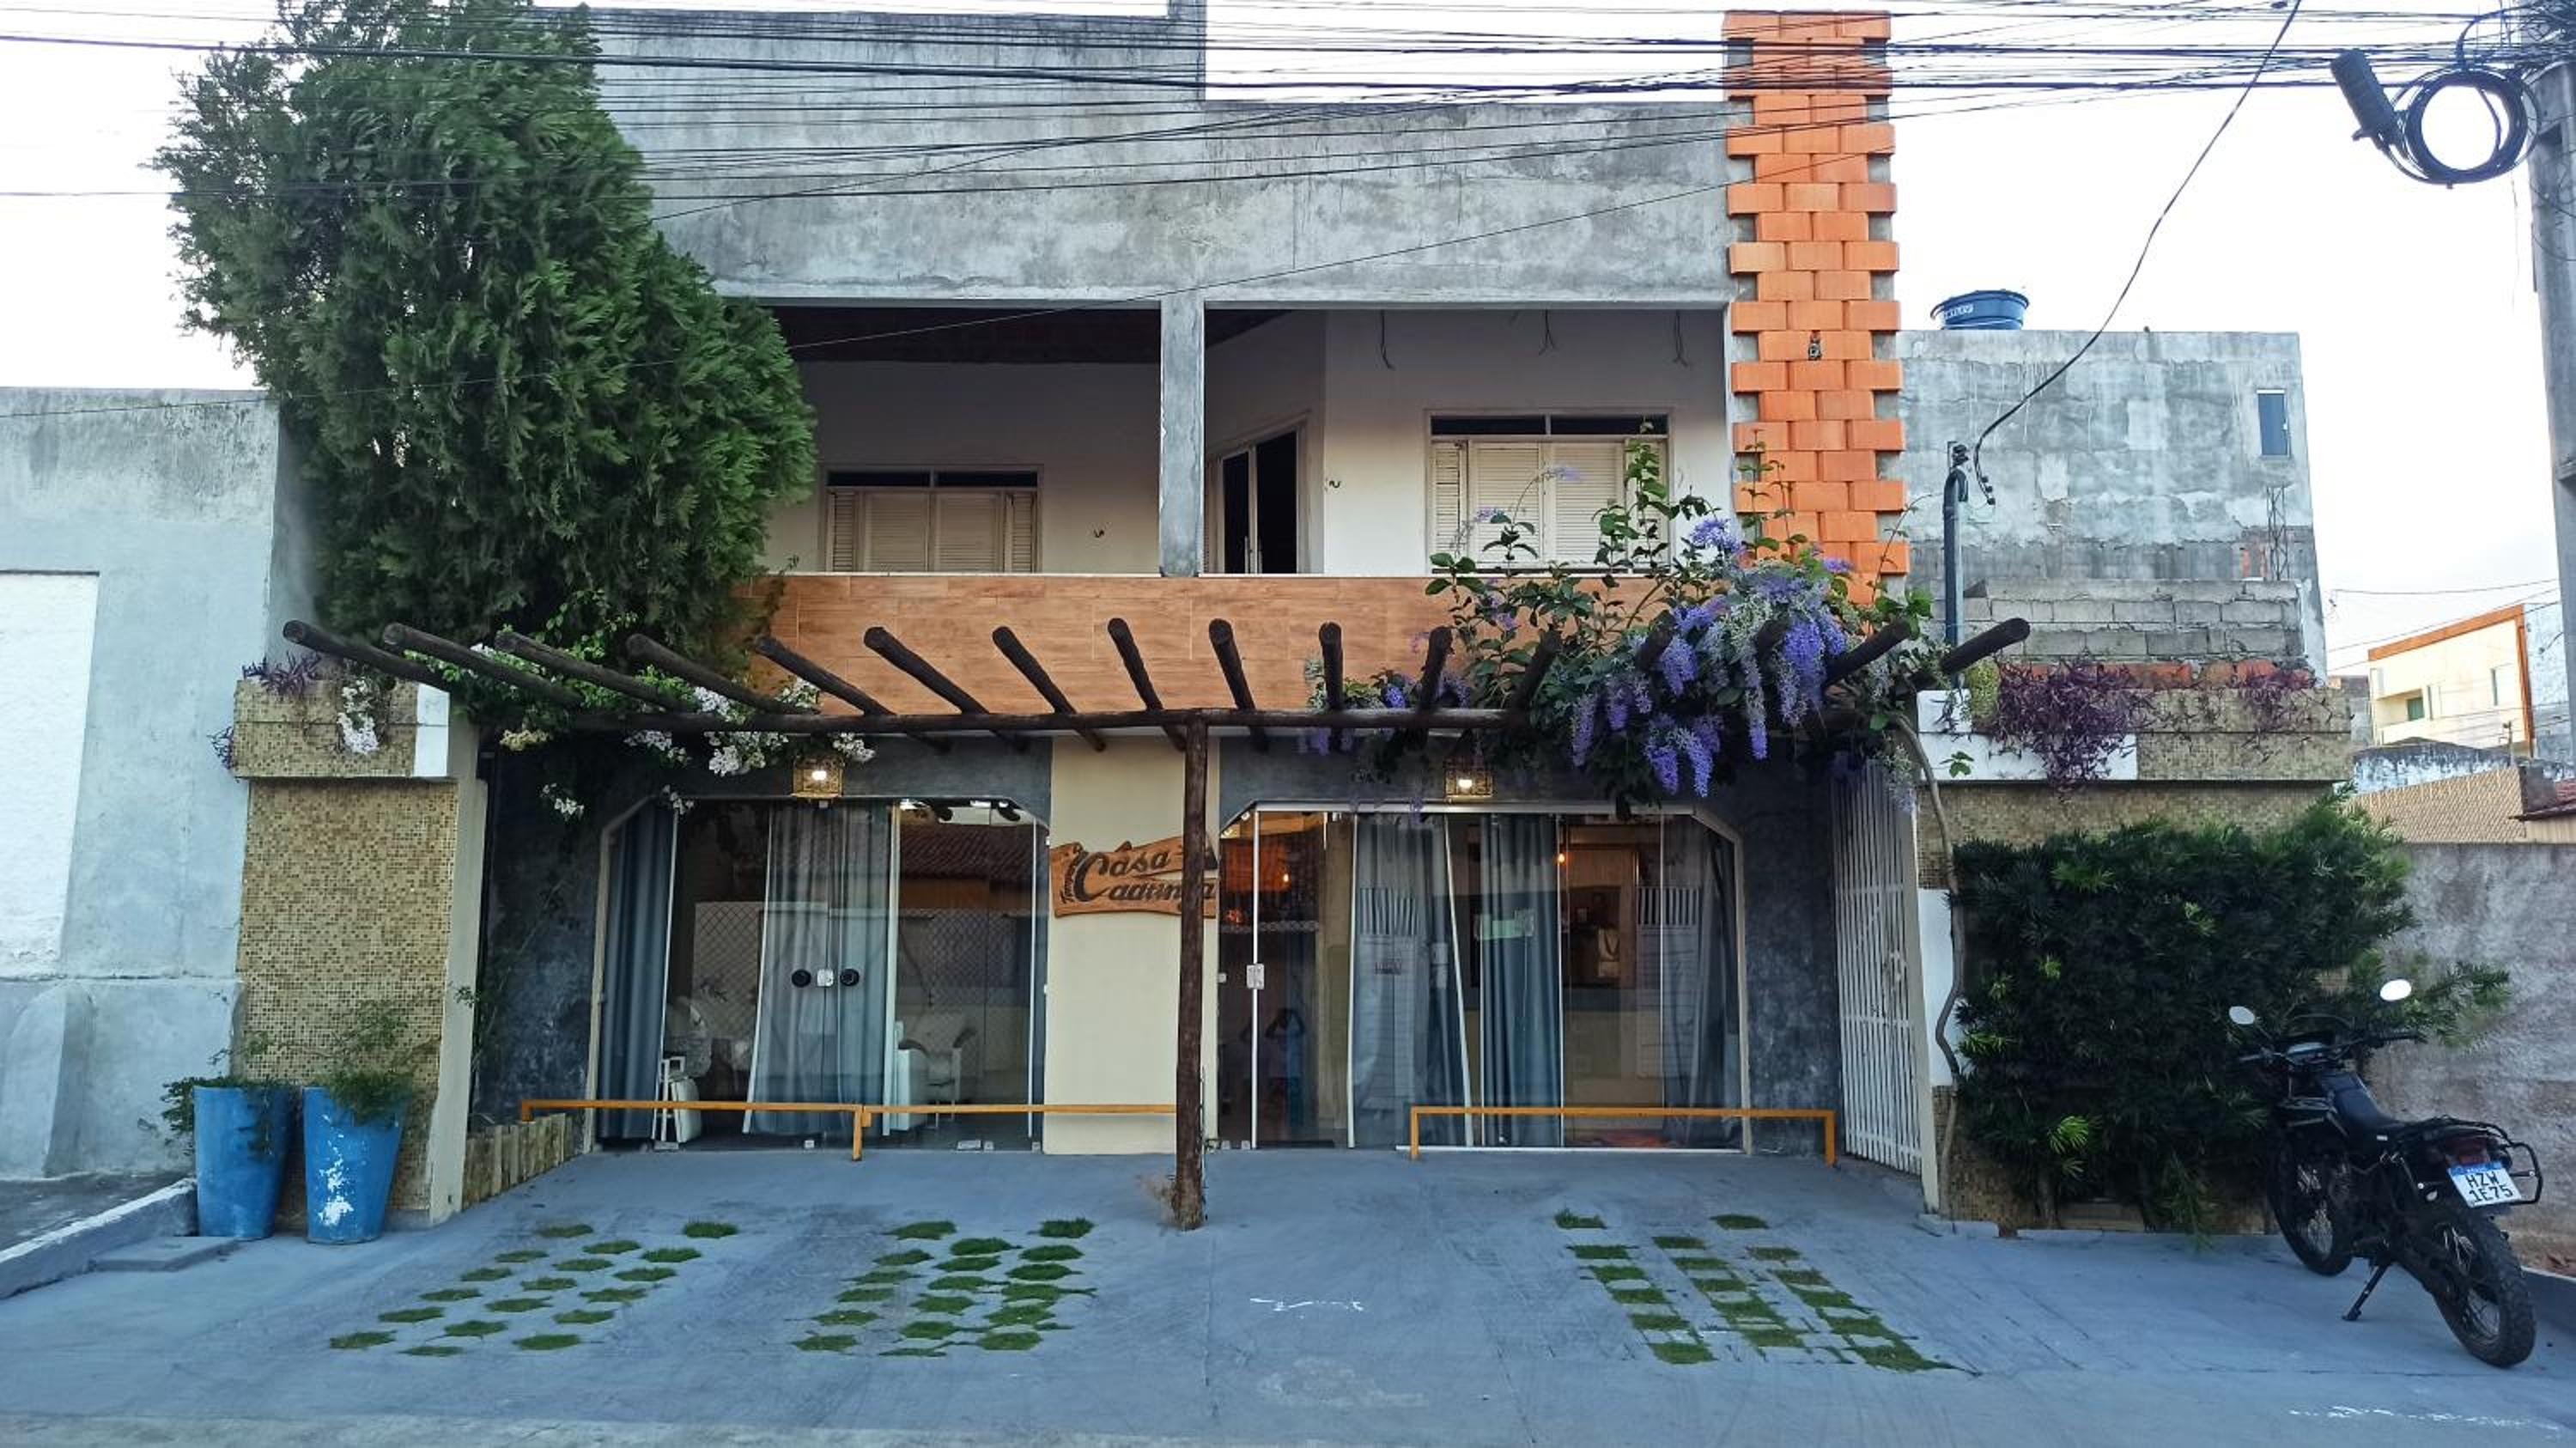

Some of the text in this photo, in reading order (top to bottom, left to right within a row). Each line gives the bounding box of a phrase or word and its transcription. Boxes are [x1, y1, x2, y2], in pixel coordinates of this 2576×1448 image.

[1073, 850, 1171, 902] Casa
[2465, 1171, 2499, 1188] HZW
[2470, 1184, 2512, 1202] 1E75
